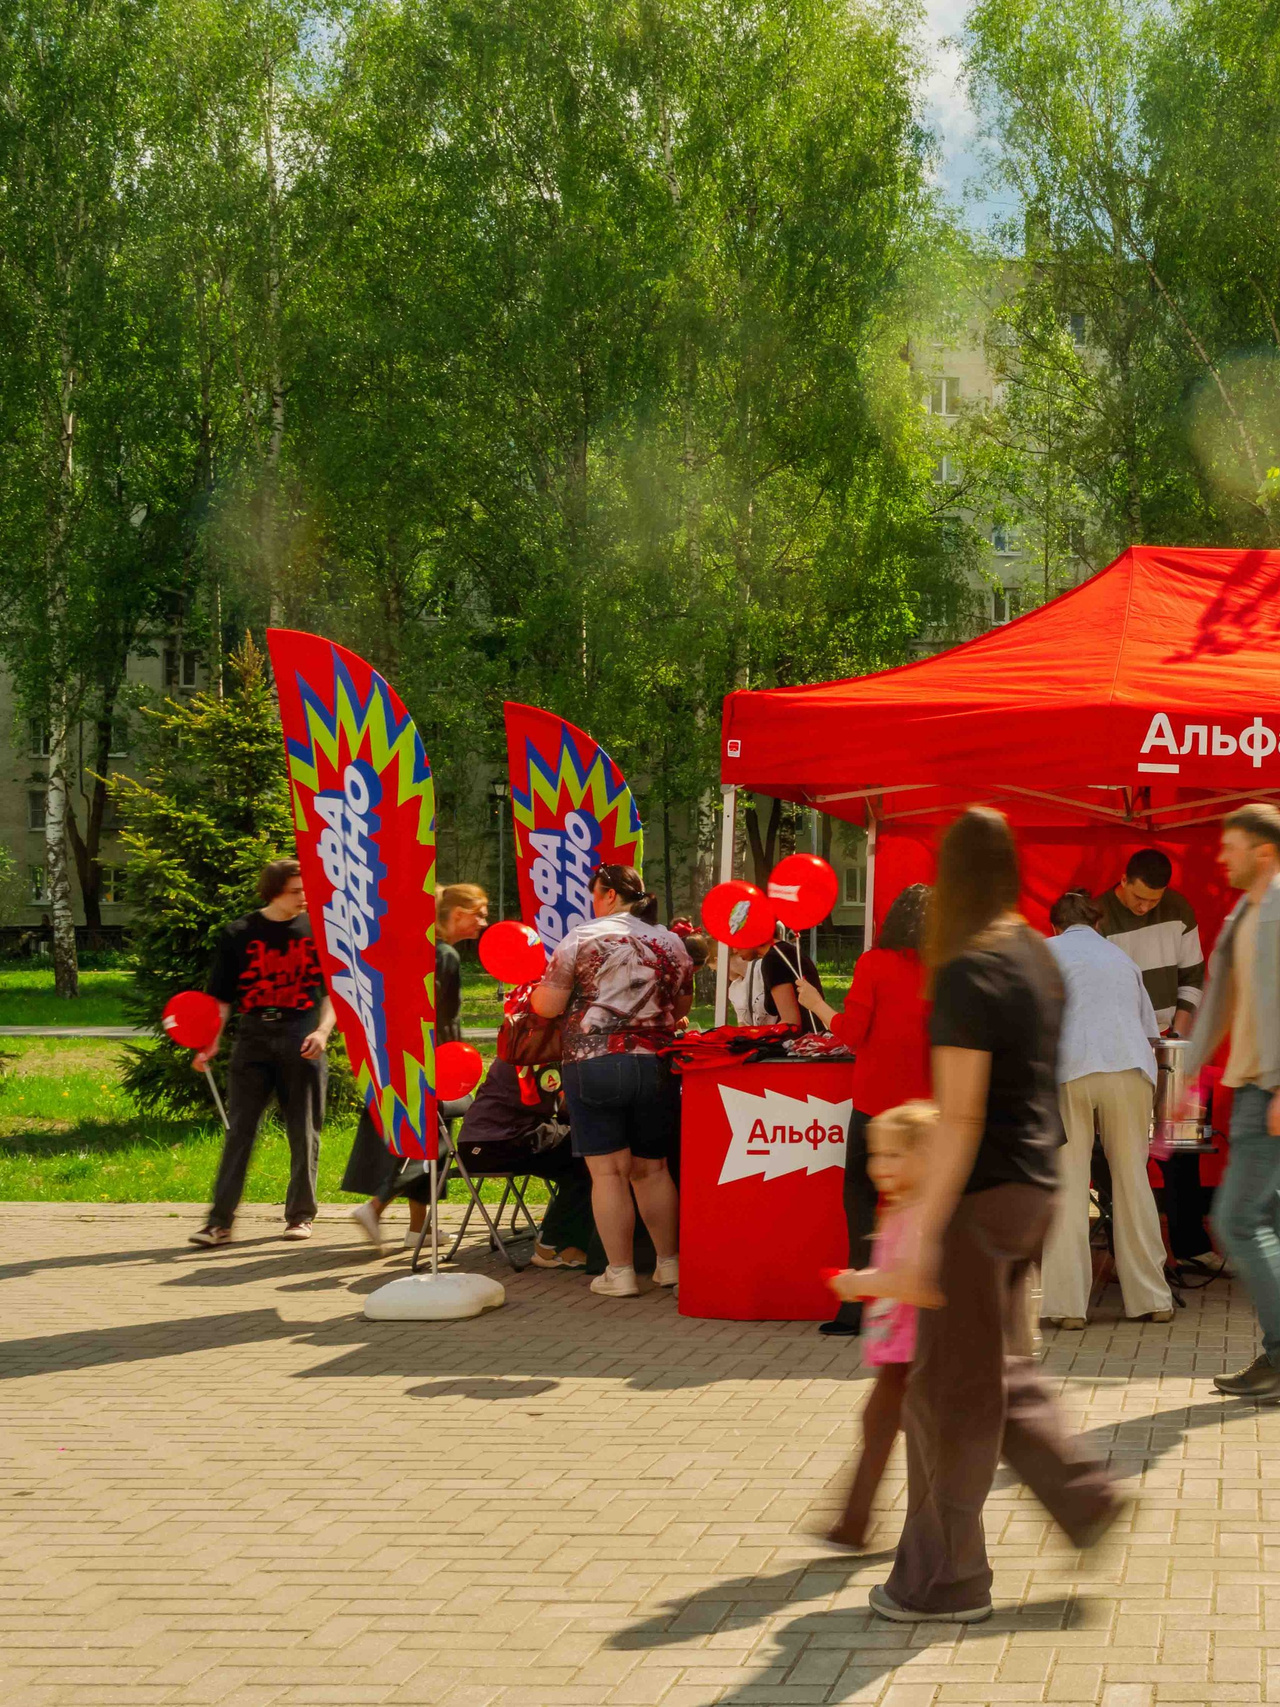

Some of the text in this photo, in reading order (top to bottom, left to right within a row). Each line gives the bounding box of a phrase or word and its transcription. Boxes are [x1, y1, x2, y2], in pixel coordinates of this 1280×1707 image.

[314, 796, 363, 1025] АЛЬФА
[344, 765, 383, 1089] ЫГОДНО
[747, 1118, 845, 1153] Альфа
